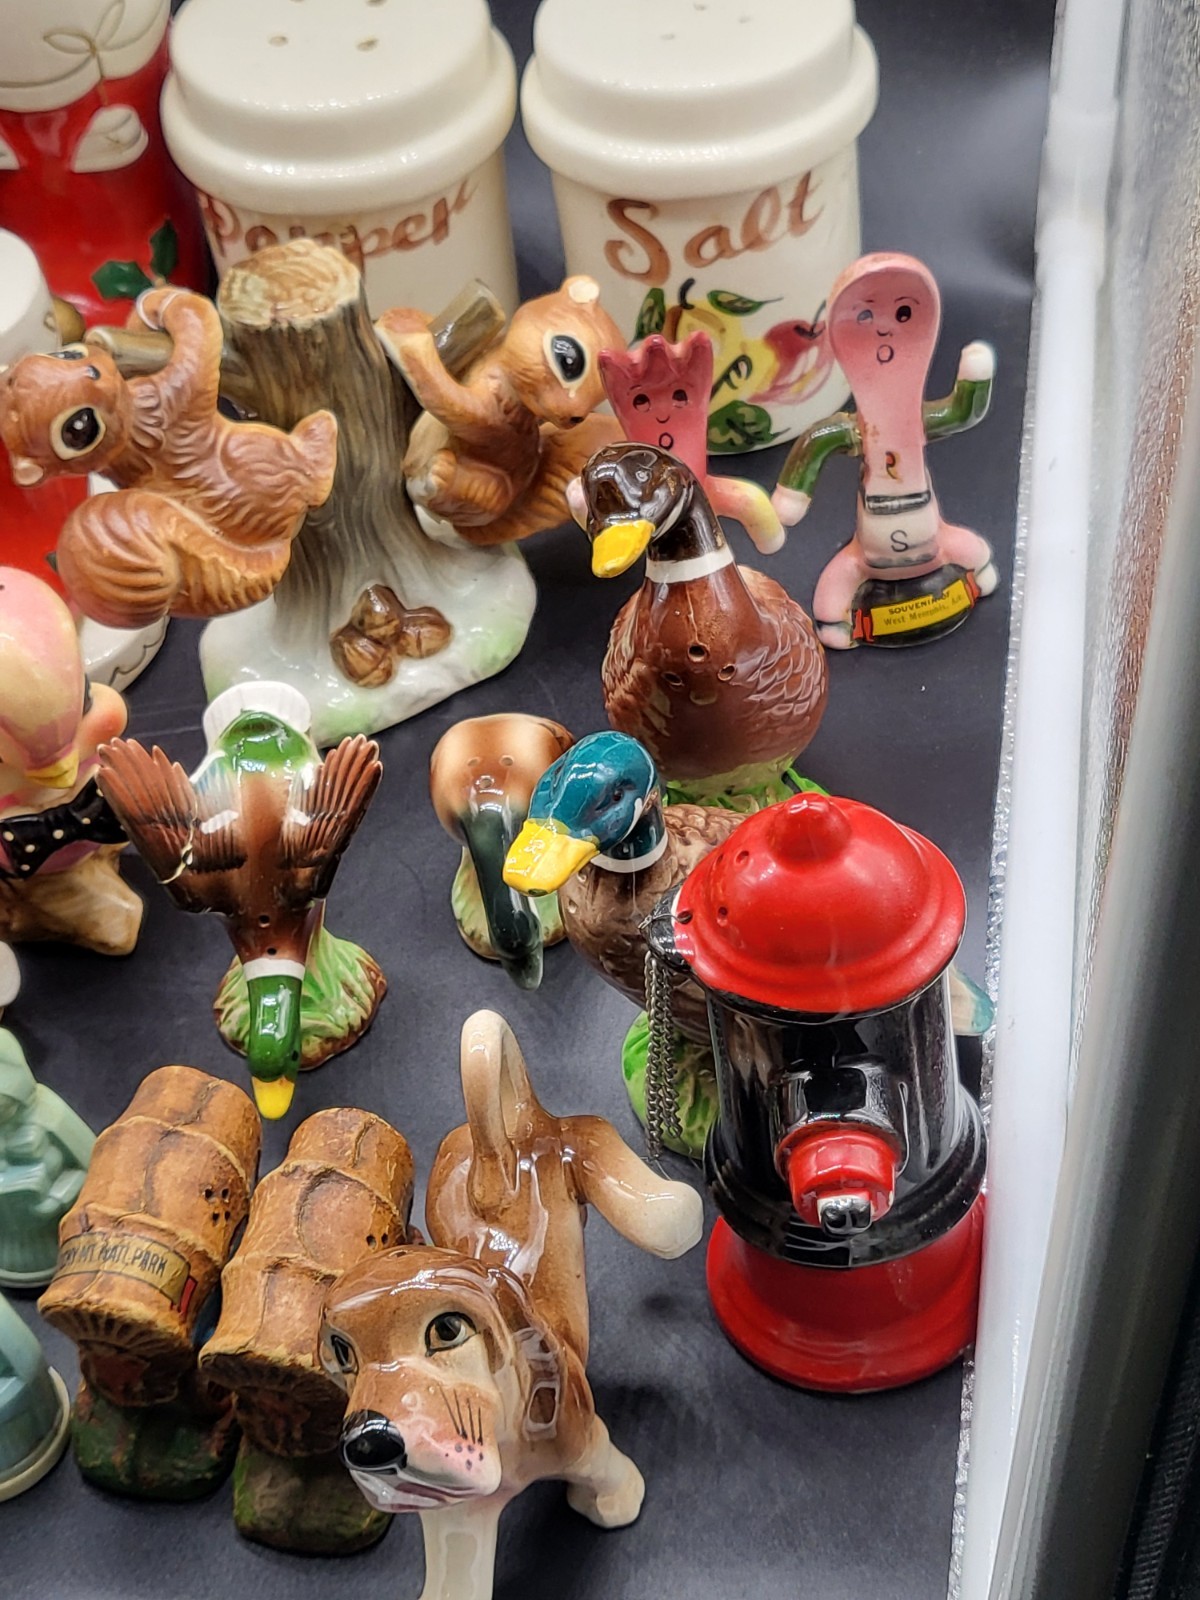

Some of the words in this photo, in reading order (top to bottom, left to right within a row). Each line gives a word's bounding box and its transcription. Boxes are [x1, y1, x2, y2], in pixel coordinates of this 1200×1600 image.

[604, 170, 824, 286] Salt
[890, 530, 909, 552] S
[883, 615, 905, 627] West
[131, 1247, 168, 1278] PARK
